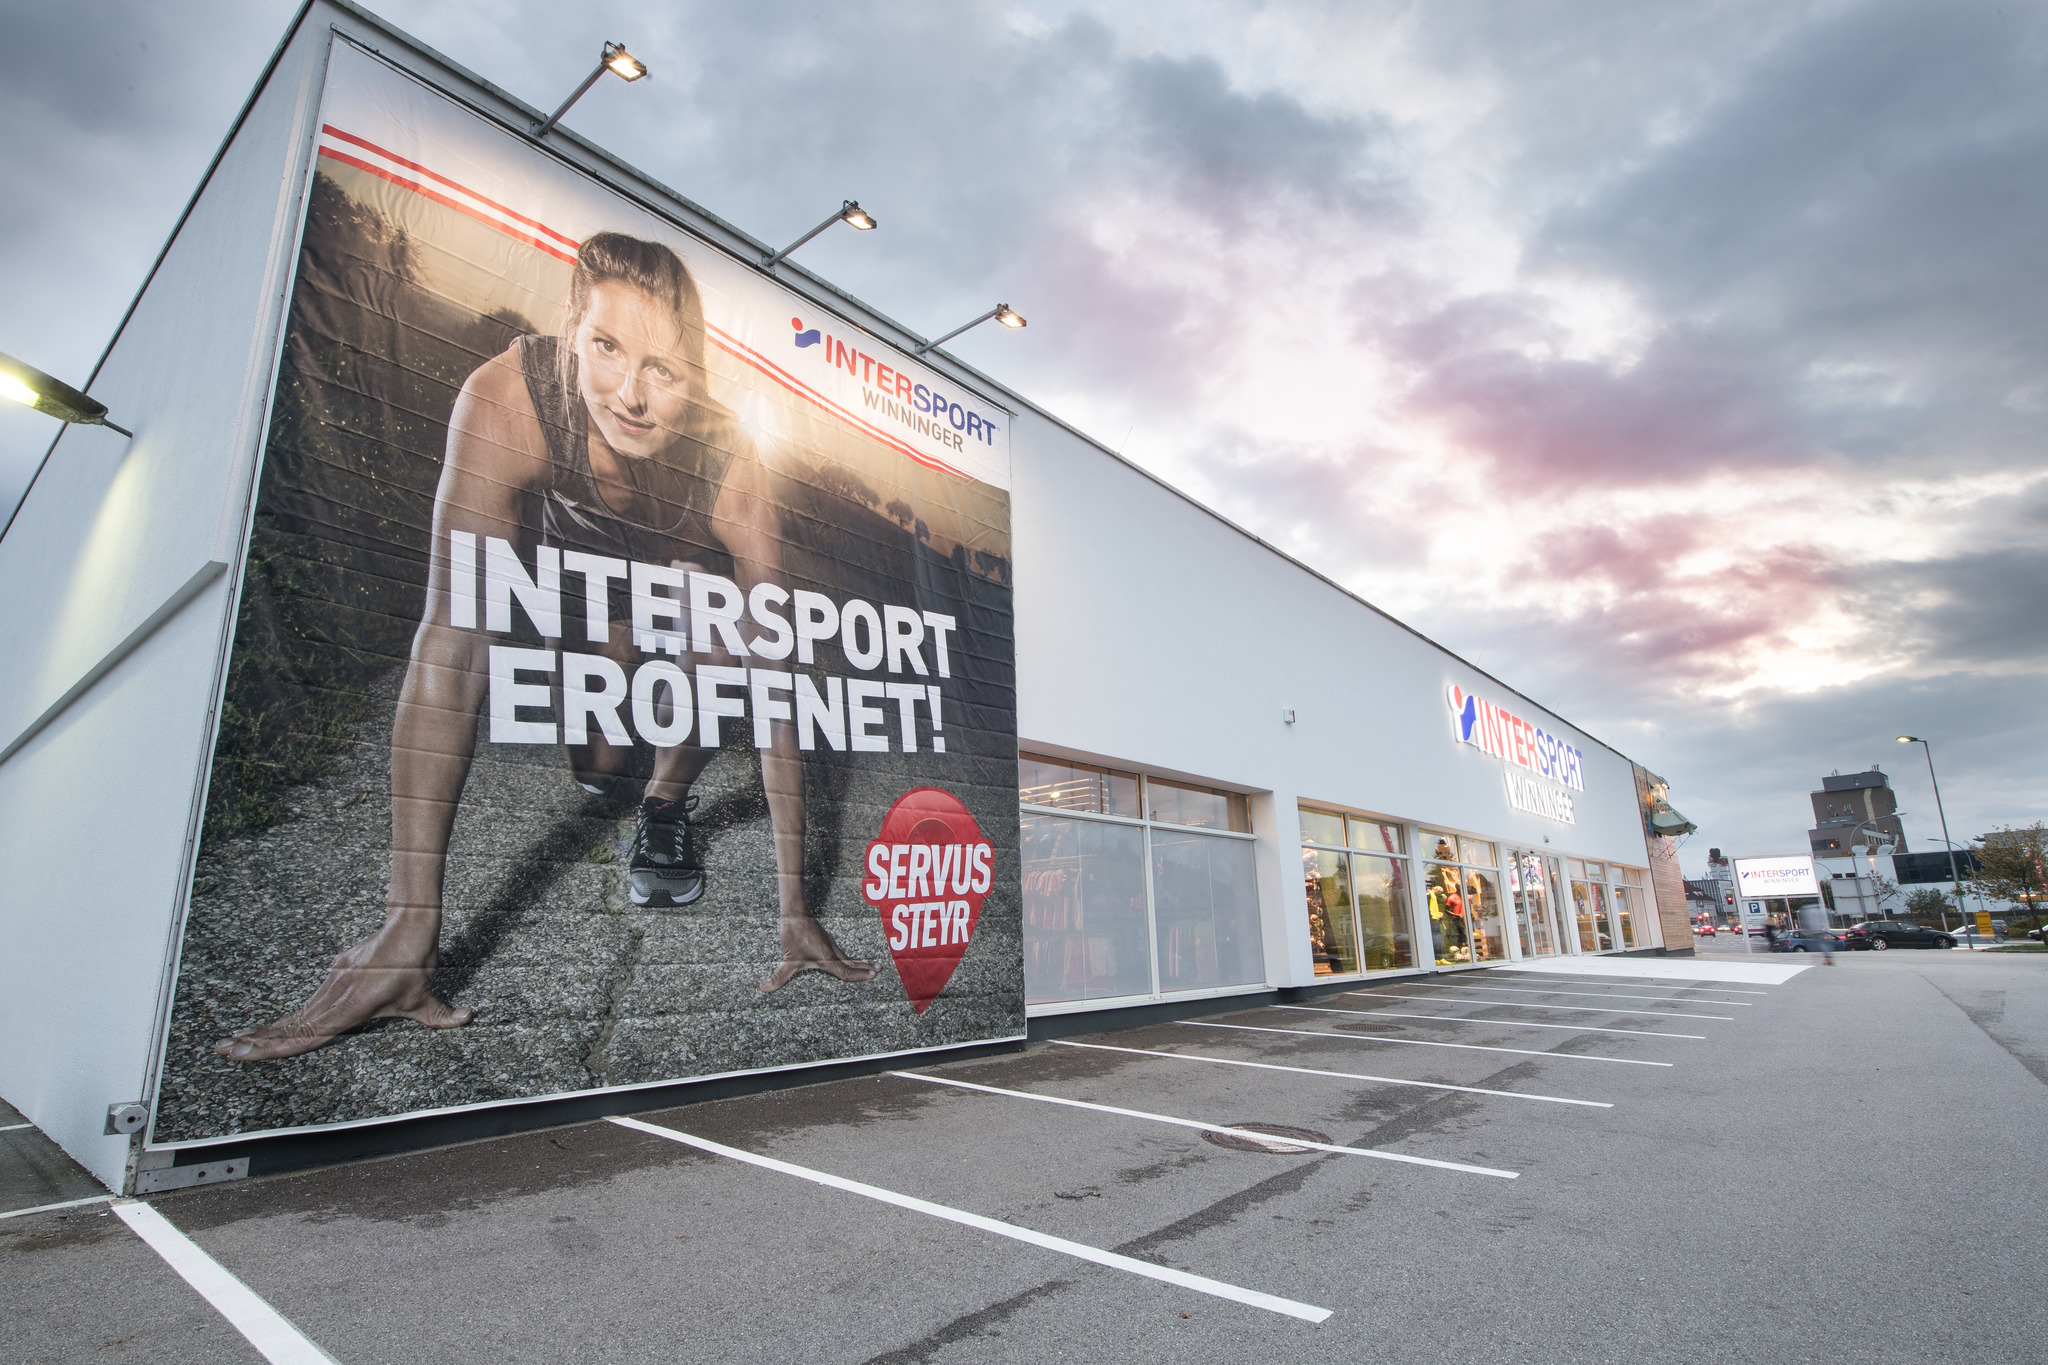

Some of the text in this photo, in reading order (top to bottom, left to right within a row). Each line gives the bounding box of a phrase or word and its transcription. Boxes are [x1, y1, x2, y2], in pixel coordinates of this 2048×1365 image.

[826, 334, 996, 446] INTERSPORT
[862, 386, 964, 454] WINNINGER
[450, 529, 957, 679] INTERSPORT
[488, 633, 947, 754] ERÖFFNET!
[1477, 696, 1586, 793] INTERSPORT
[1504, 773, 1576, 825] WINNINGER
[865, 843, 992, 901] SERVUS
[1750, 868, 1810, 879] INTERSPORT
[889, 900, 971, 951] STEYR
